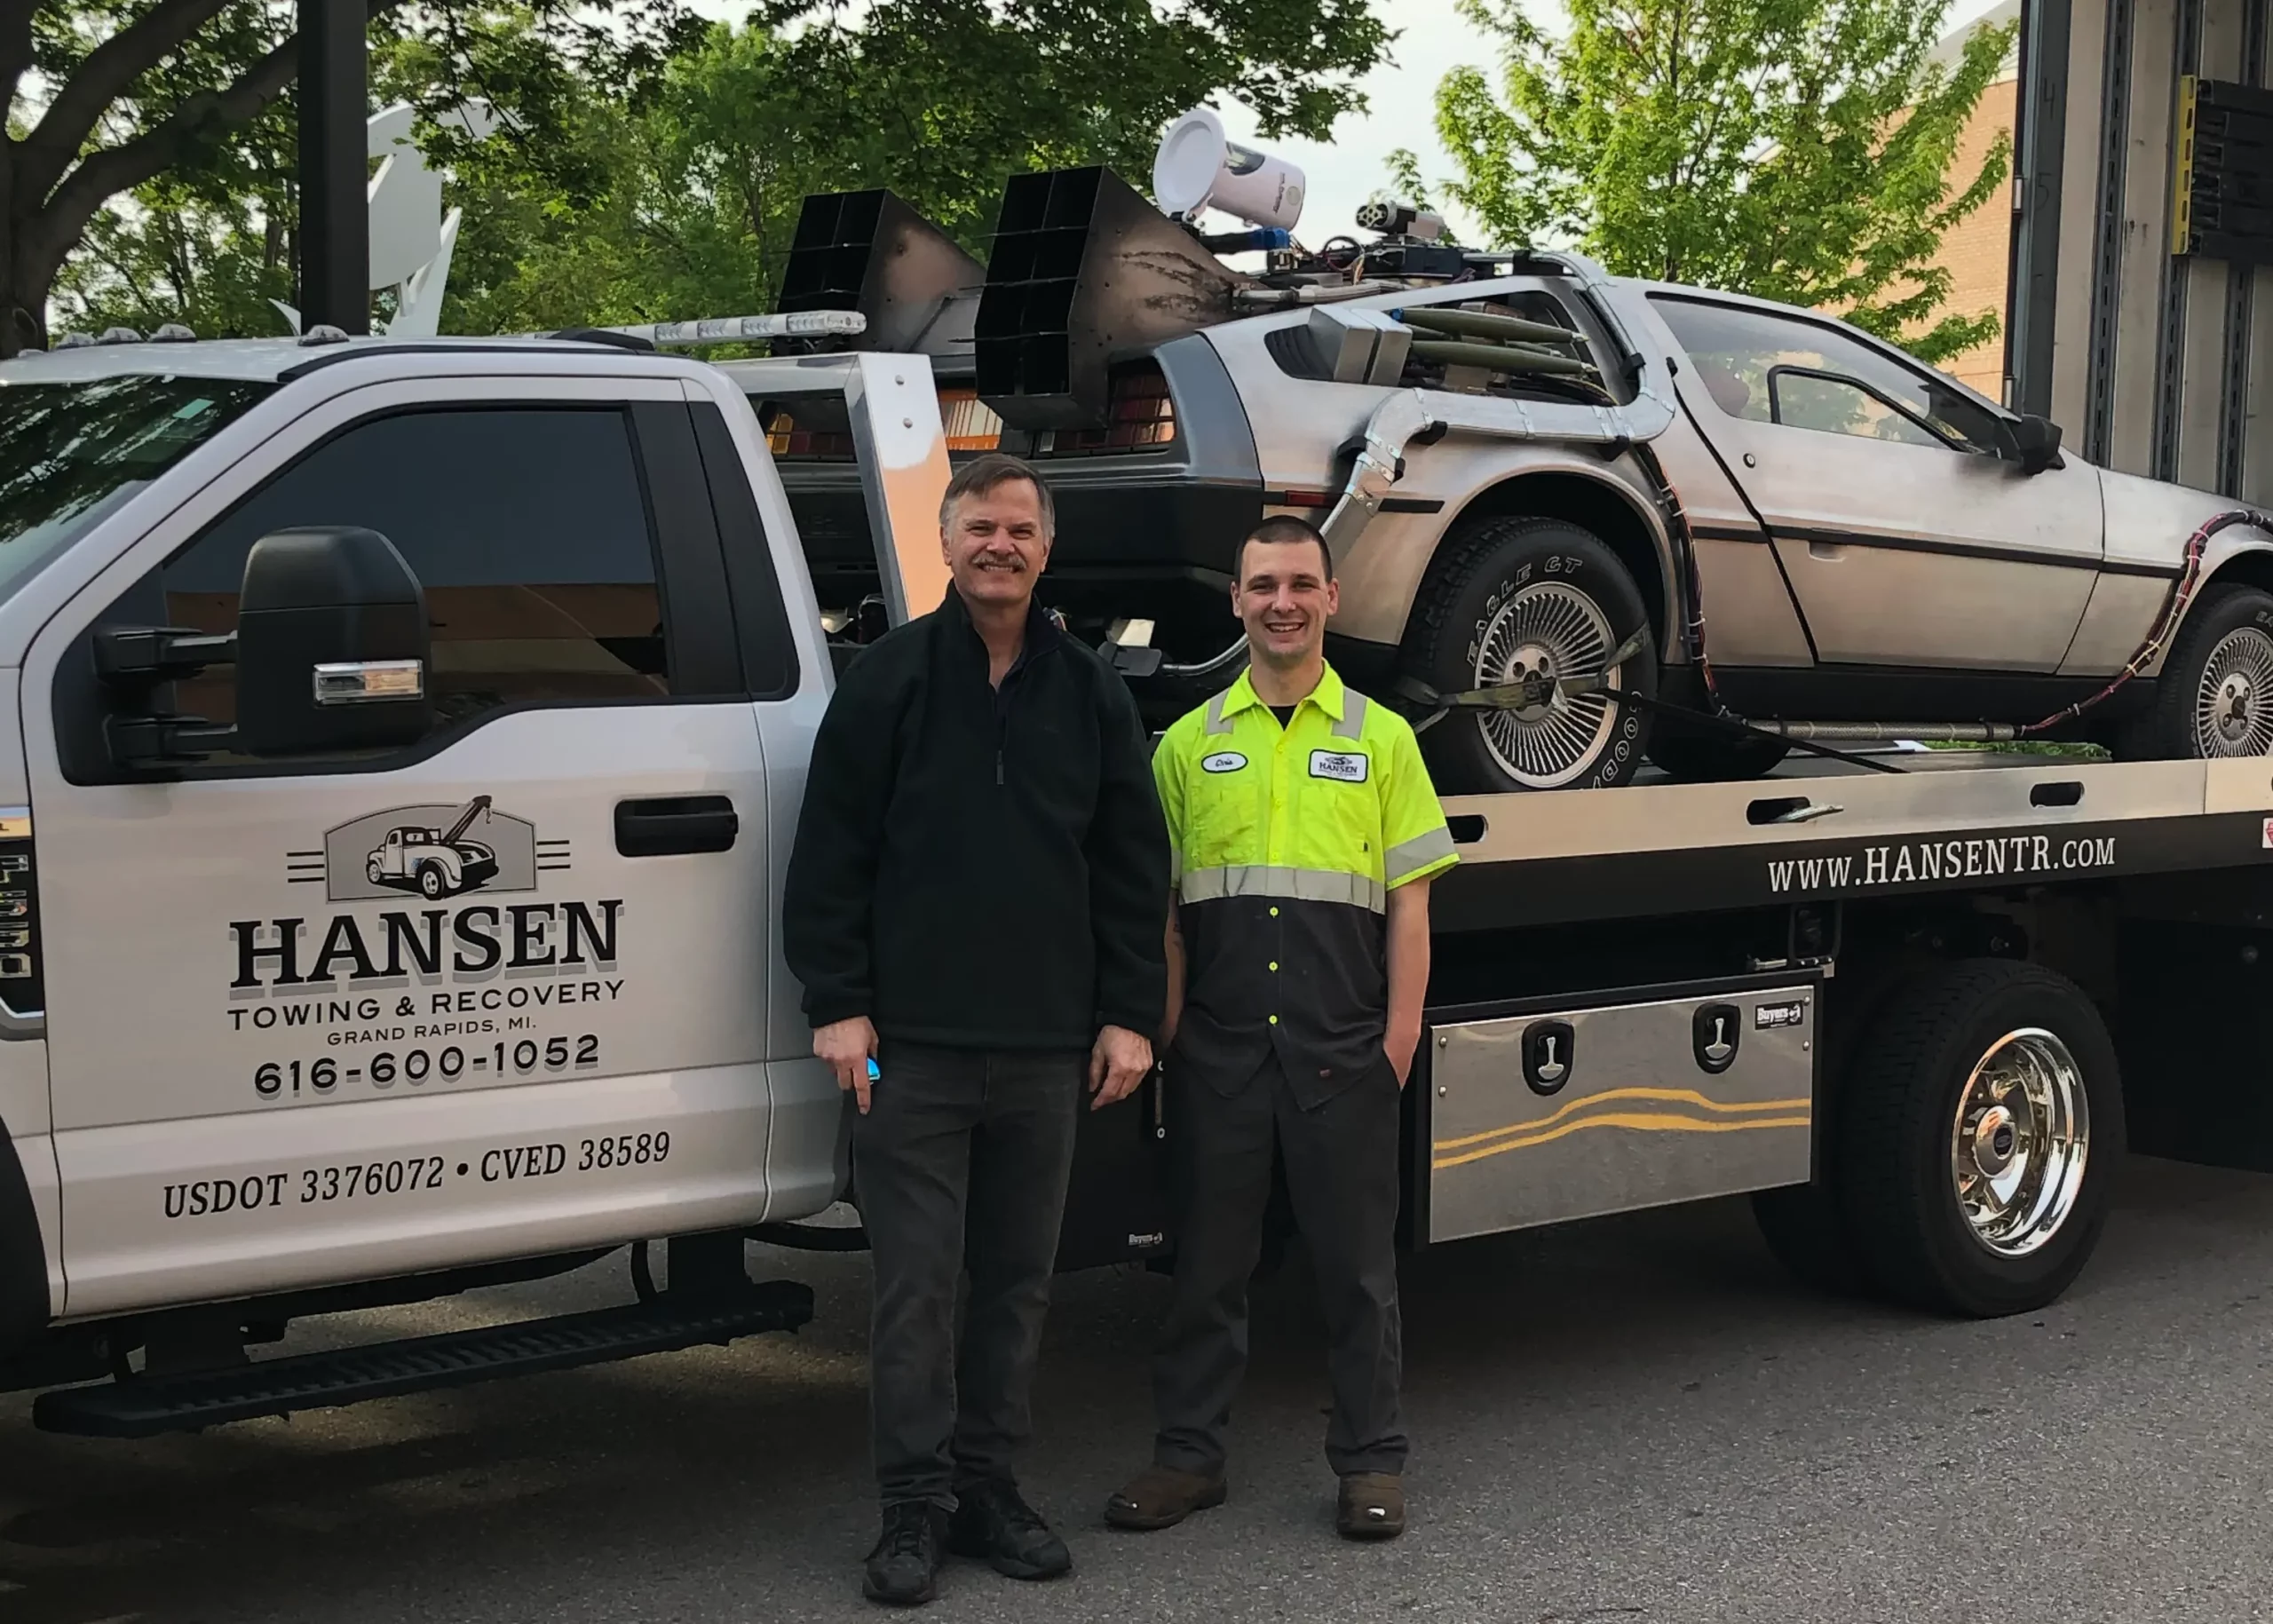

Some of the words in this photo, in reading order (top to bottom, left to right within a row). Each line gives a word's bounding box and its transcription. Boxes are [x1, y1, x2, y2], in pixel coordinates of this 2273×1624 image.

[1544, 556, 1583, 574] GT
[1319, 762, 1358, 773] HANSEN
[1768, 836, 2116, 892] WWW.HANSENTR.COM
[229, 899, 624, 992] HANSEN
[227, 999, 381, 1031] TOWING
[396, 995, 416, 1017] &
[432, 979, 625, 1015] RECOVERY
[327, 1027, 406, 1046] GRAND
[414, 1020, 501, 1038] RAPIDS,
[508, 1016, 537, 1030] MI.
[1757, 1007, 1789, 1023] Buyers
[254, 1034, 599, 1097] 616-600-1052
[163, 1173, 289, 1218] USDOT
[300, 1157, 444, 1203] 3376072
[480, 1144, 566, 1182] CVED
[578, 1131, 670, 1171] 38589
